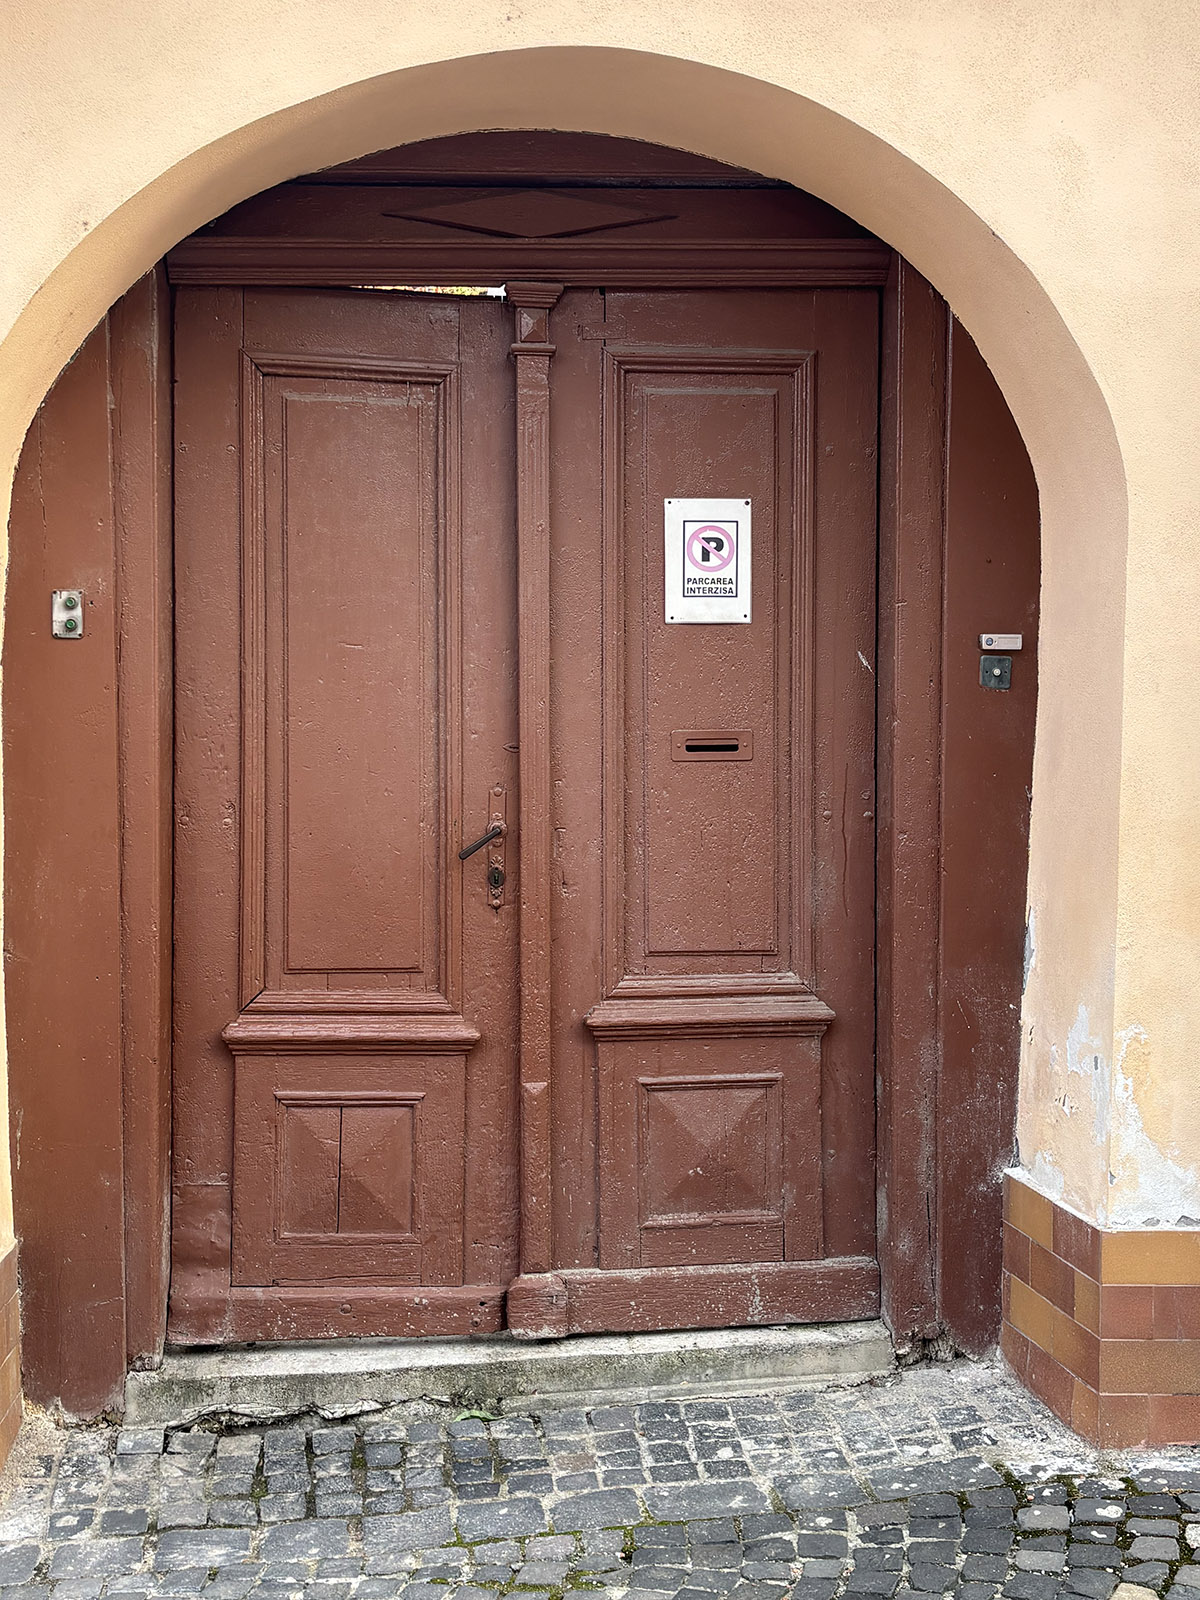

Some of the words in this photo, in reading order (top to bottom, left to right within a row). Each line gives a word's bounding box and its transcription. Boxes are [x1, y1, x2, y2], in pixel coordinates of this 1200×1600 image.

[702, 537, 724, 562] P
[686, 577, 734, 585] PARCAREA
[686, 586, 734, 595] INTERZISA
